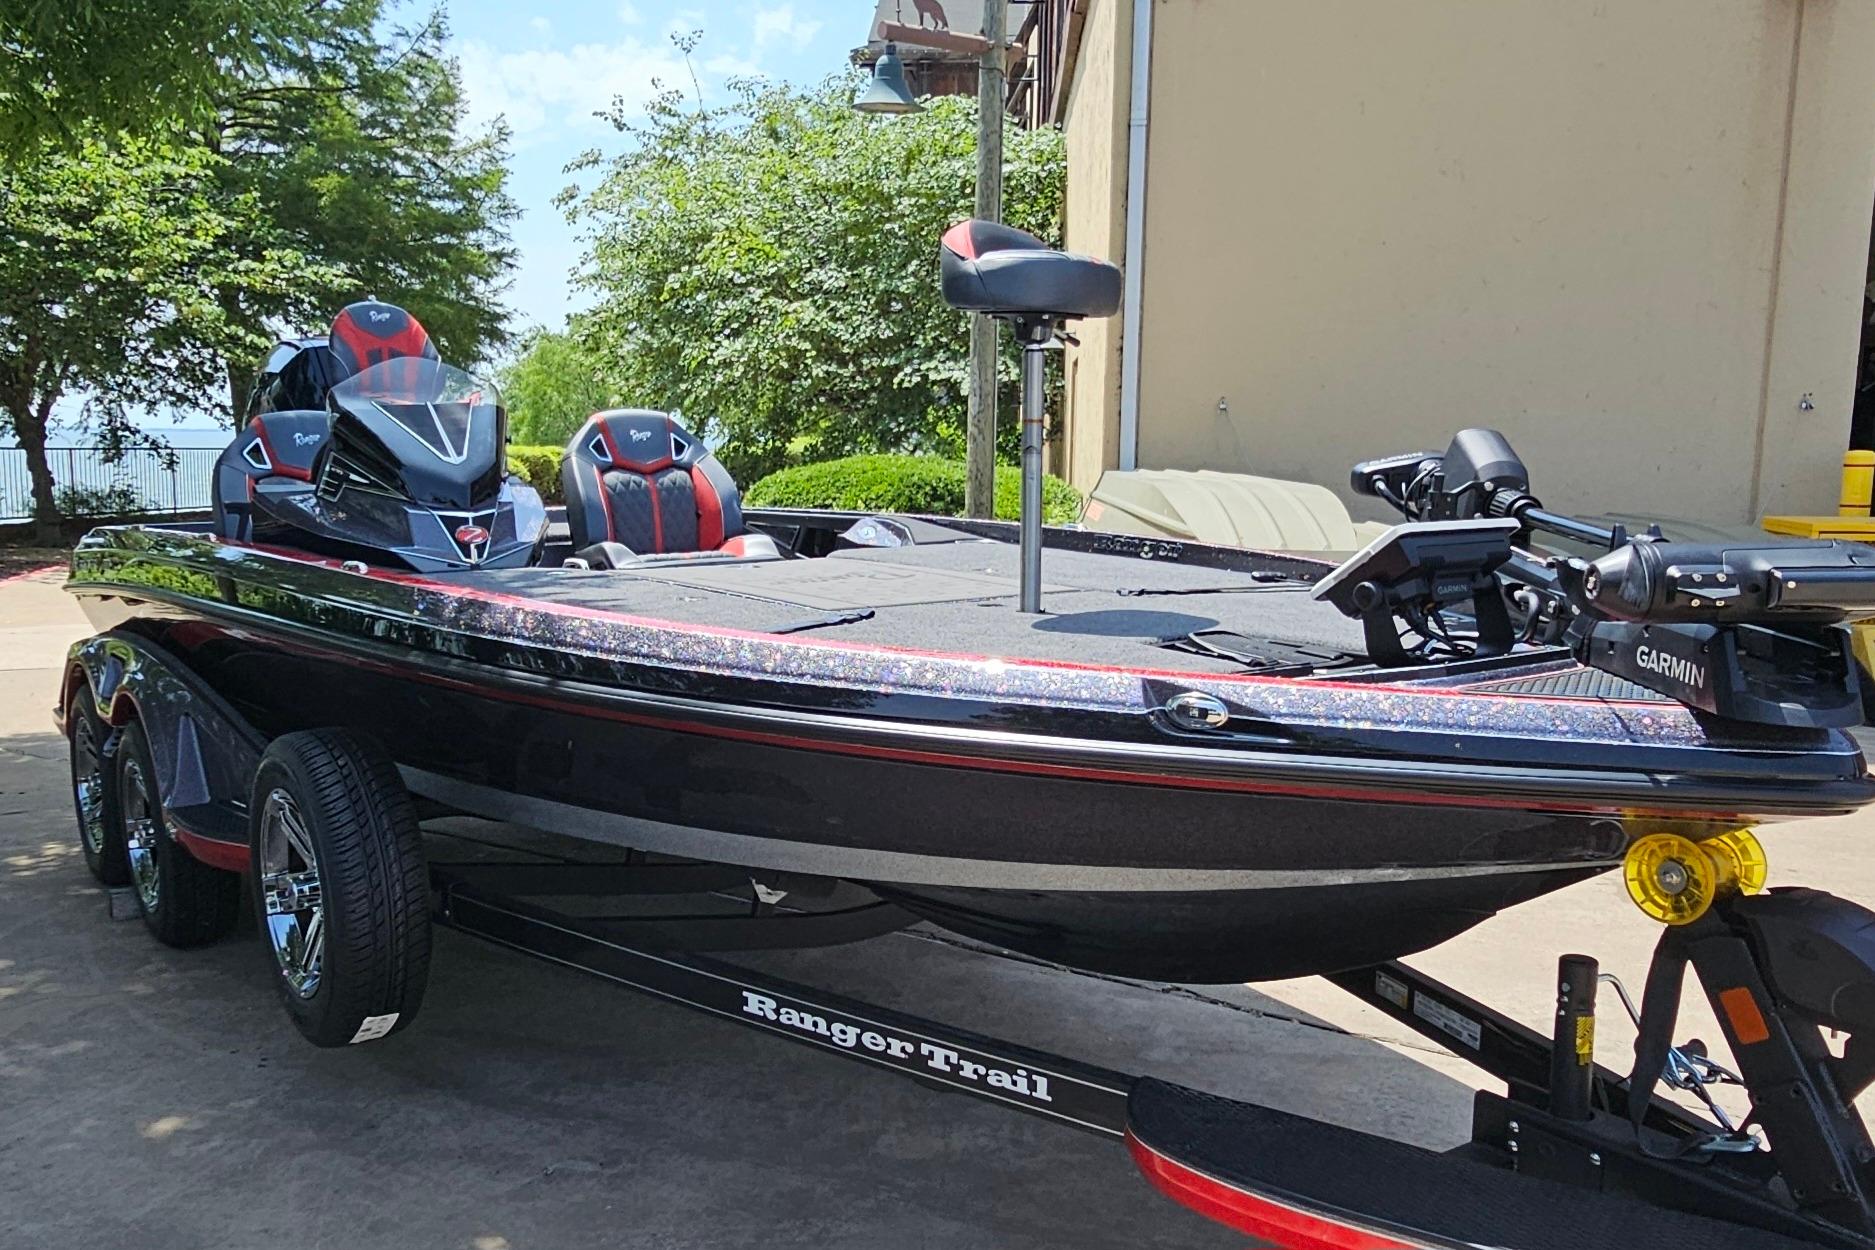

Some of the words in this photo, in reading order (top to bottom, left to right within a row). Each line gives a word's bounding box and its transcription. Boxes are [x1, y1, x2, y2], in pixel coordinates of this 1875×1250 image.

[1437, 584, 1468, 595] GARMIN
[1636, 645, 1705, 689] GARMIN
[742, 991, 915, 1059] Ranger
[920, 1042, 1053, 1102] Trail
